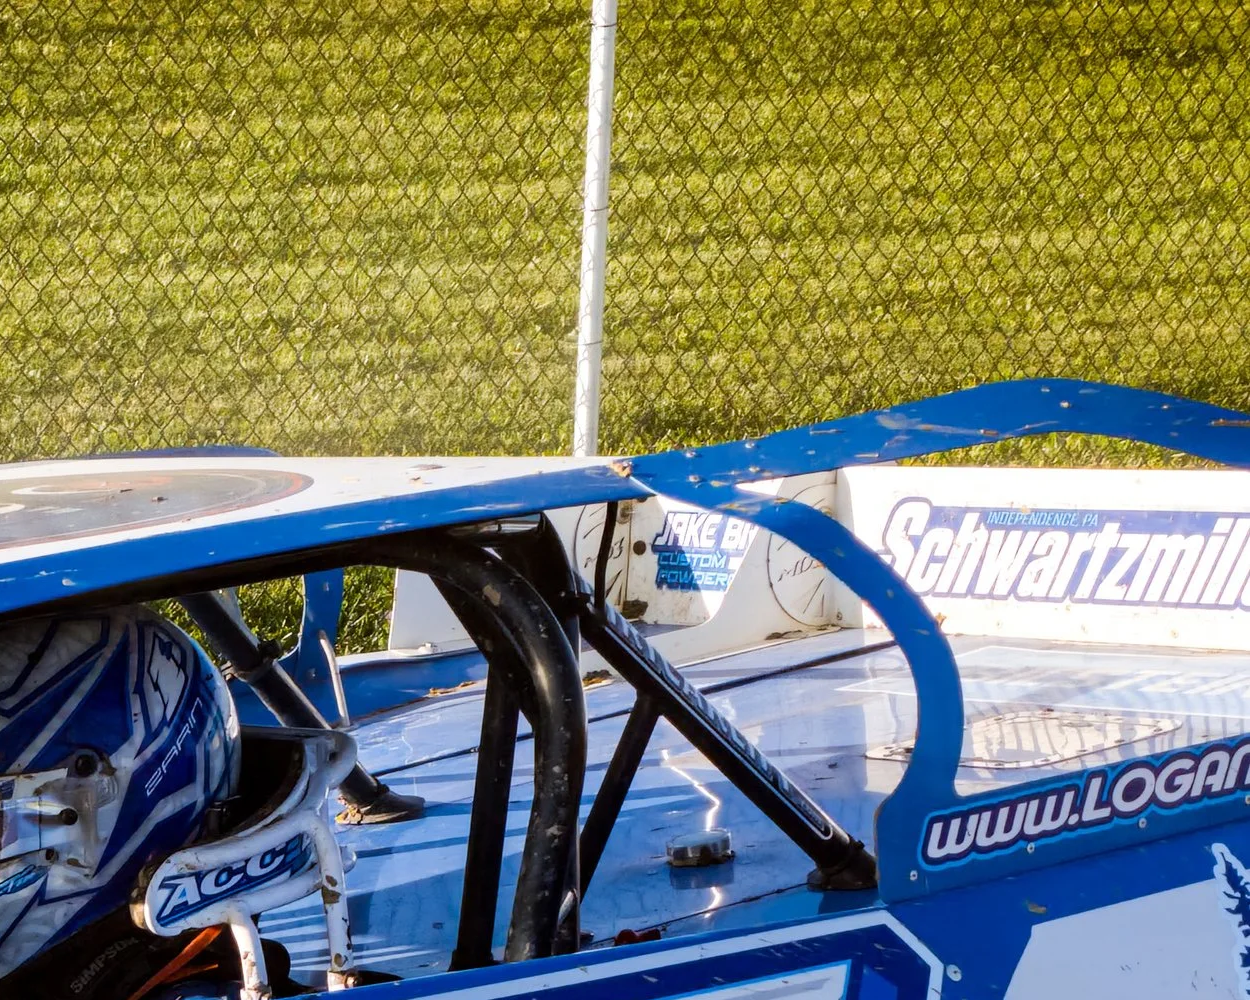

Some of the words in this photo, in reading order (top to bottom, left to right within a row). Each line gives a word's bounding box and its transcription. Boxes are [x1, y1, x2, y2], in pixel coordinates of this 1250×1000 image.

[653, 511, 723, 549] JAKE
[1083, 512, 1099, 528] PA
[658, 549, 726, 569] CUSTOM
[882, 498, 1250, 608] Schwartzmill
